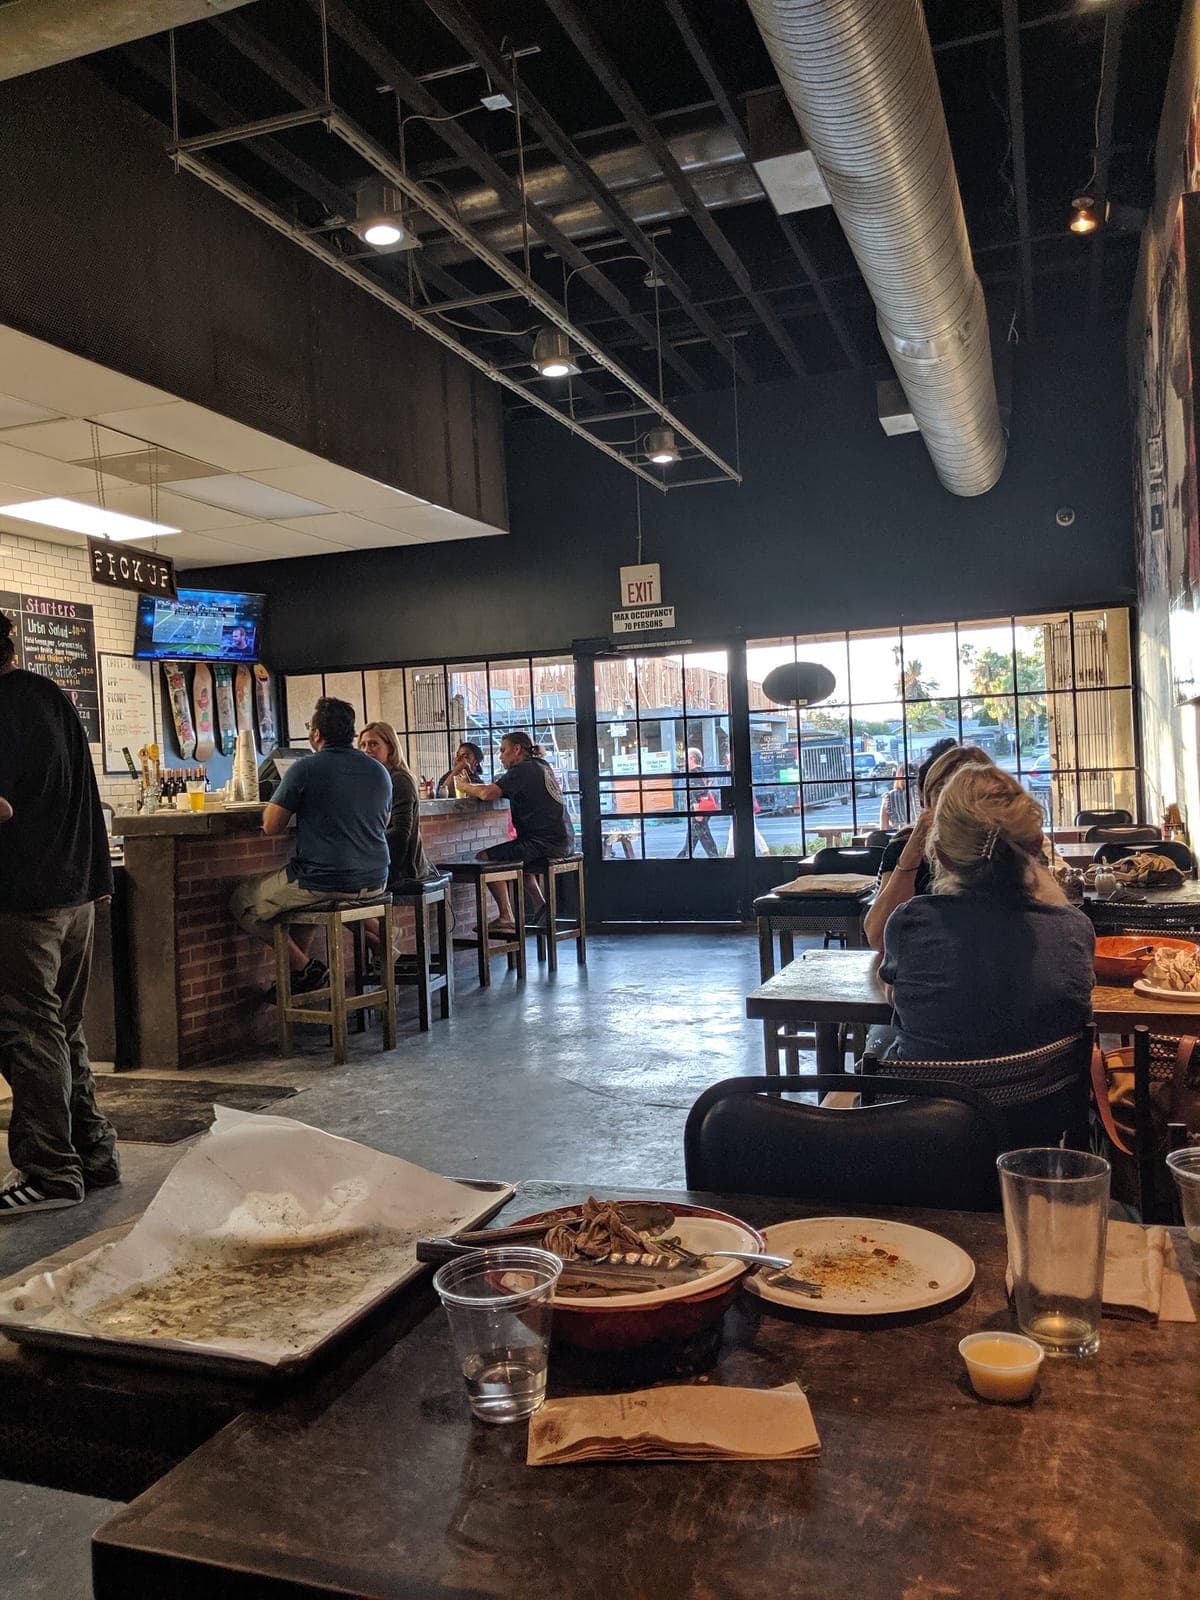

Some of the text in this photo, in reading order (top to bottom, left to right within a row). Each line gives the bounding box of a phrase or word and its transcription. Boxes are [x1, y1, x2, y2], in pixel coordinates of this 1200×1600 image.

[94, 550, 143, 583] PICK
[627, 581, 653, 604] EXIT
[26, 598, 76, 618] Starters
[614, 608, 673, 621] MAX OCCUPANCY
[624, 619, 663, 630] 70 PERSONS
